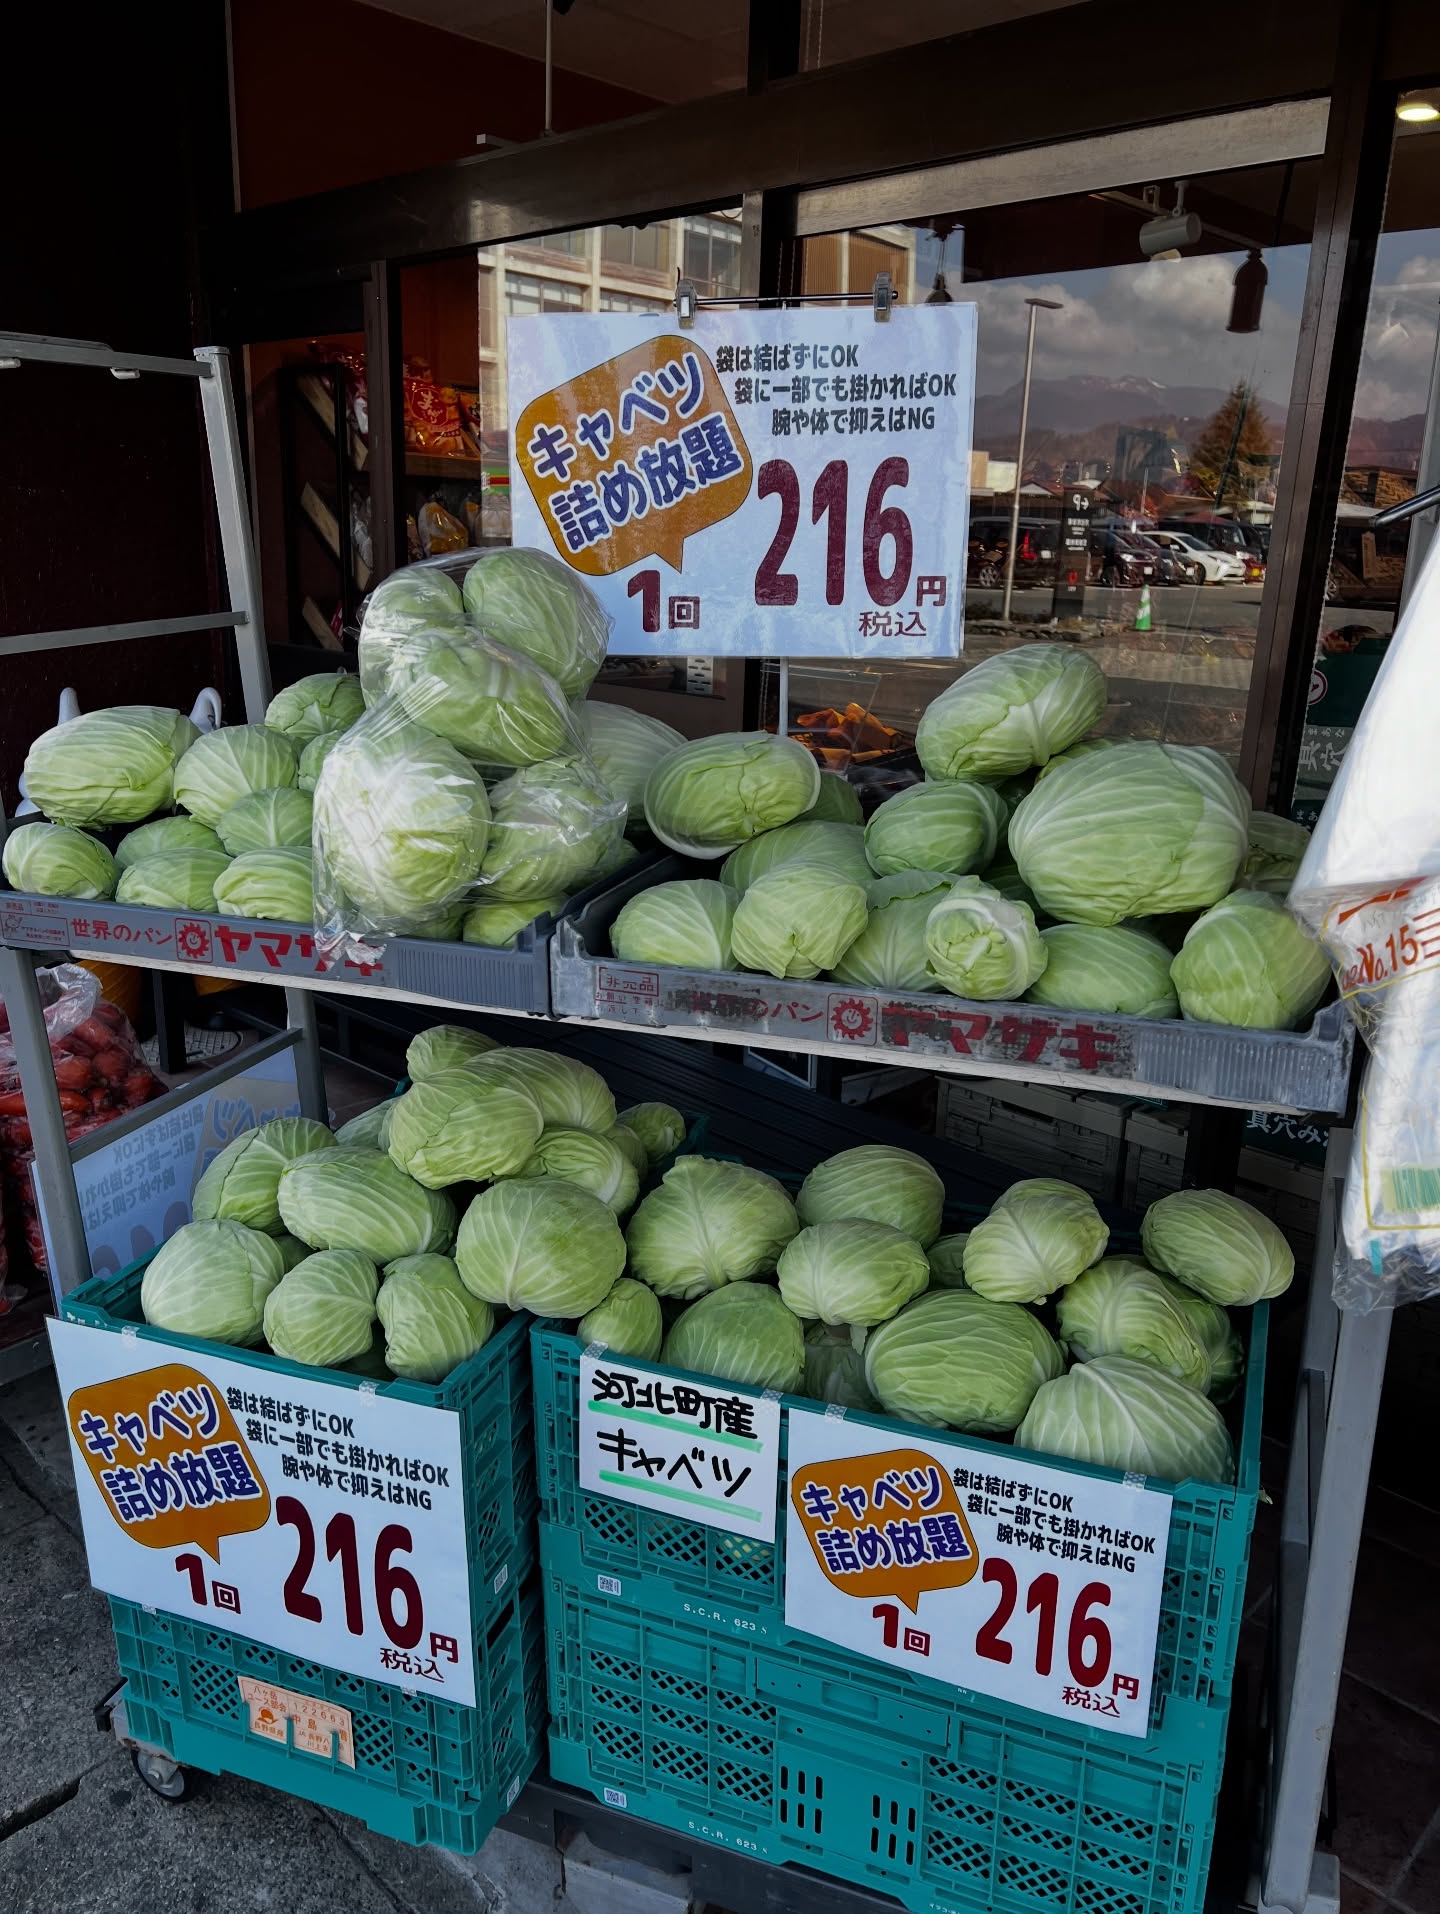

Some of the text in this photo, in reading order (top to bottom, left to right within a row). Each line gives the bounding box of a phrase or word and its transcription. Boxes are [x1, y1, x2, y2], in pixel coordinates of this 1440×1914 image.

[716, 344, 858, 373] 袋は結ばずにOK
[735, 374, 956, 405] 袋に一部でも掛かればOK
[530, 355, 702, 479] キャベツ
[772, 407, 935, 436] 腕や体で抑えはNG
[552, 414, 742, 551] 詰め放題
[858, 611, 927, 637] 税込
[72, 918, 173, 946] 世界のパン
[79, 1385, 220, 1463] キャベツ
[227, 1387, 354, 1438] 袋は結ばずにOK
[592, 1370, 757, 1439] 河北町産
[246, 1419, 449, 1487] 袋に一部でも掛かればOK
[597, 1428, 751, 1497] キャベツ
[104, 1443, 261, 1521] 詰め放題
[282, 1455, 432, 1510] 腕や体で抑えはNG
[803, 1467, 942, 1523] キャベツ
[953, 1468, 1073, 1512] 袋は結ばずにOK
[816, 1514, 970, 1573] 詰め放題
[967, 1494, 1155, 1554] 袋に一部でも掛かればOK
[997, 1523, 1135, 1573] 腕や体で抑えはNG
[734, 1619, 756, 1631] 623
[380, 1648, 445, 1683] 税込
[1062, 1686, 1121, 1718] 税込
[736, 1838, 757, 1850] 623
